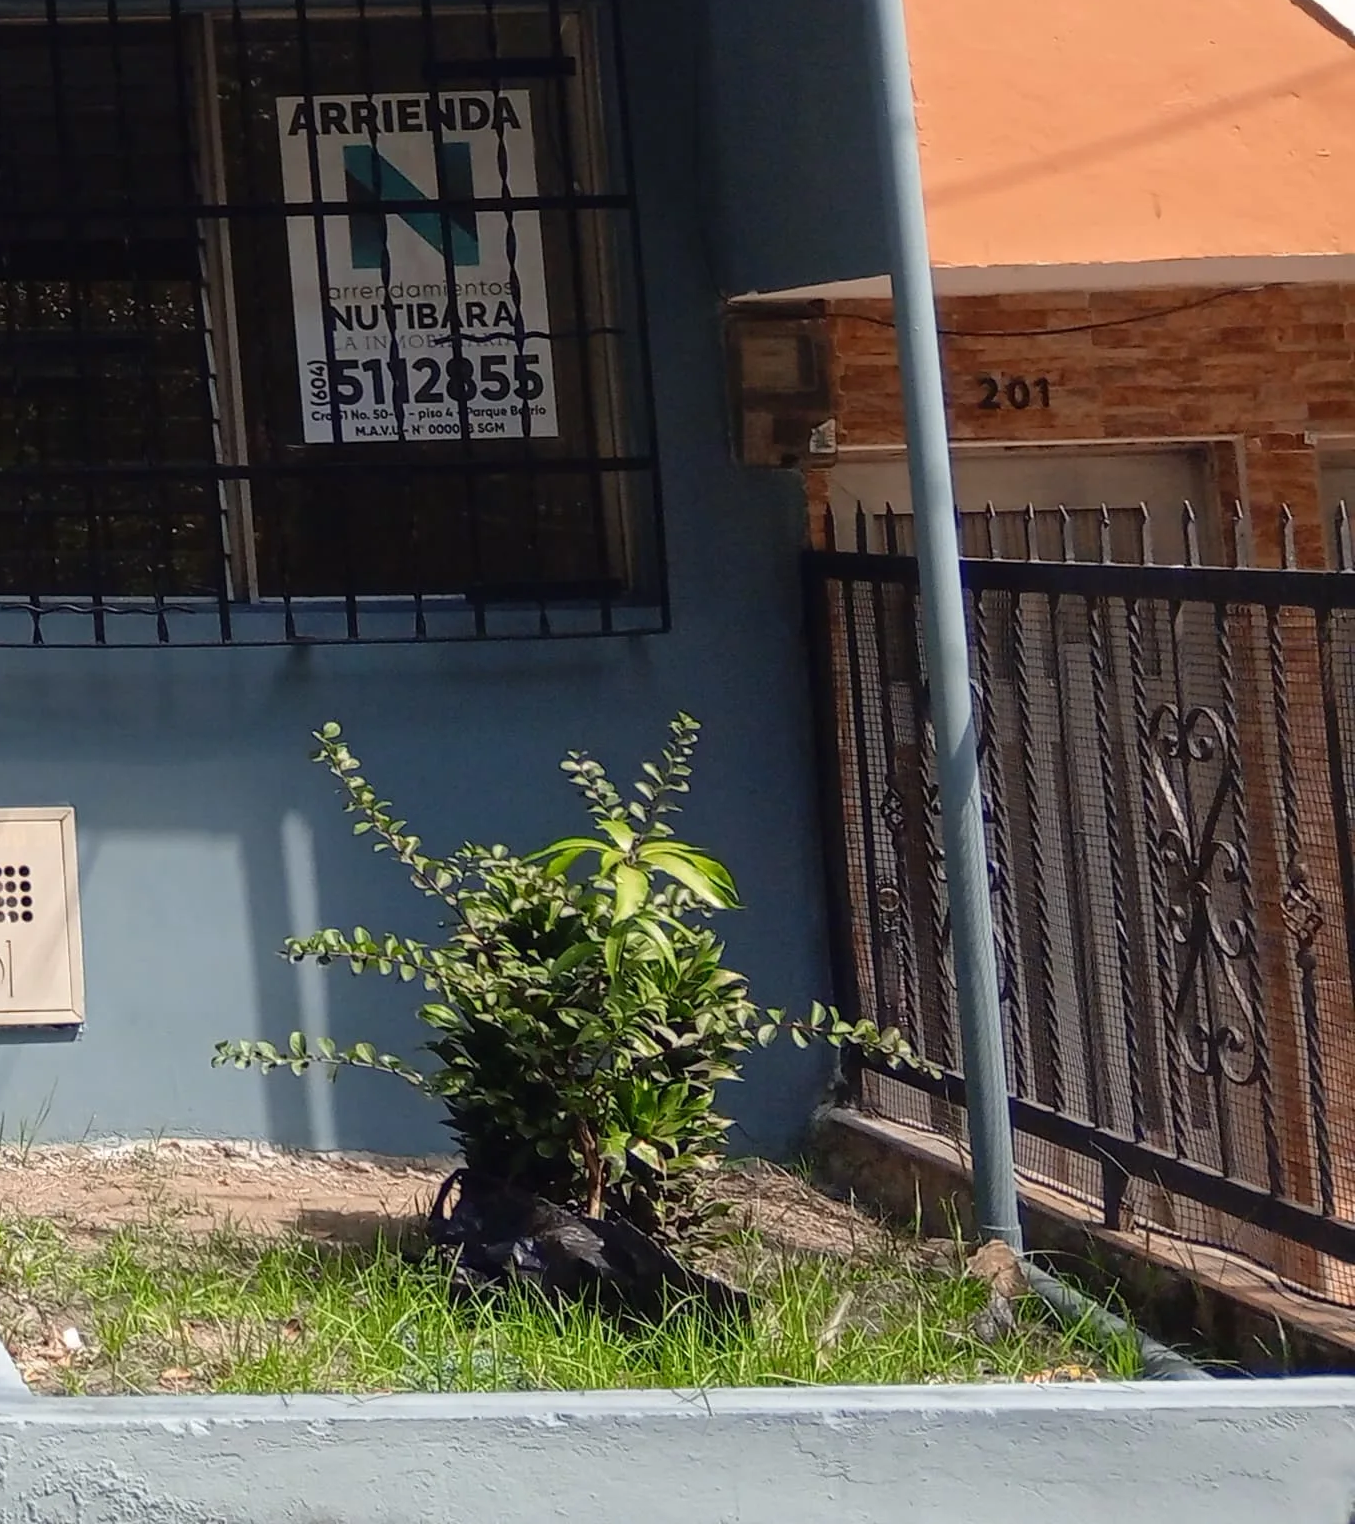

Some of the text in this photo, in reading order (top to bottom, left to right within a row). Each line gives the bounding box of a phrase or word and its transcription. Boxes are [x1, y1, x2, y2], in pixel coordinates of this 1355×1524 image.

[287, 97, 521, 135] ARRIENDA
[977, 376, 1050, 410] 201
[446, 408, 453, 417] 4
[478, 422, 505, 433] SGM
